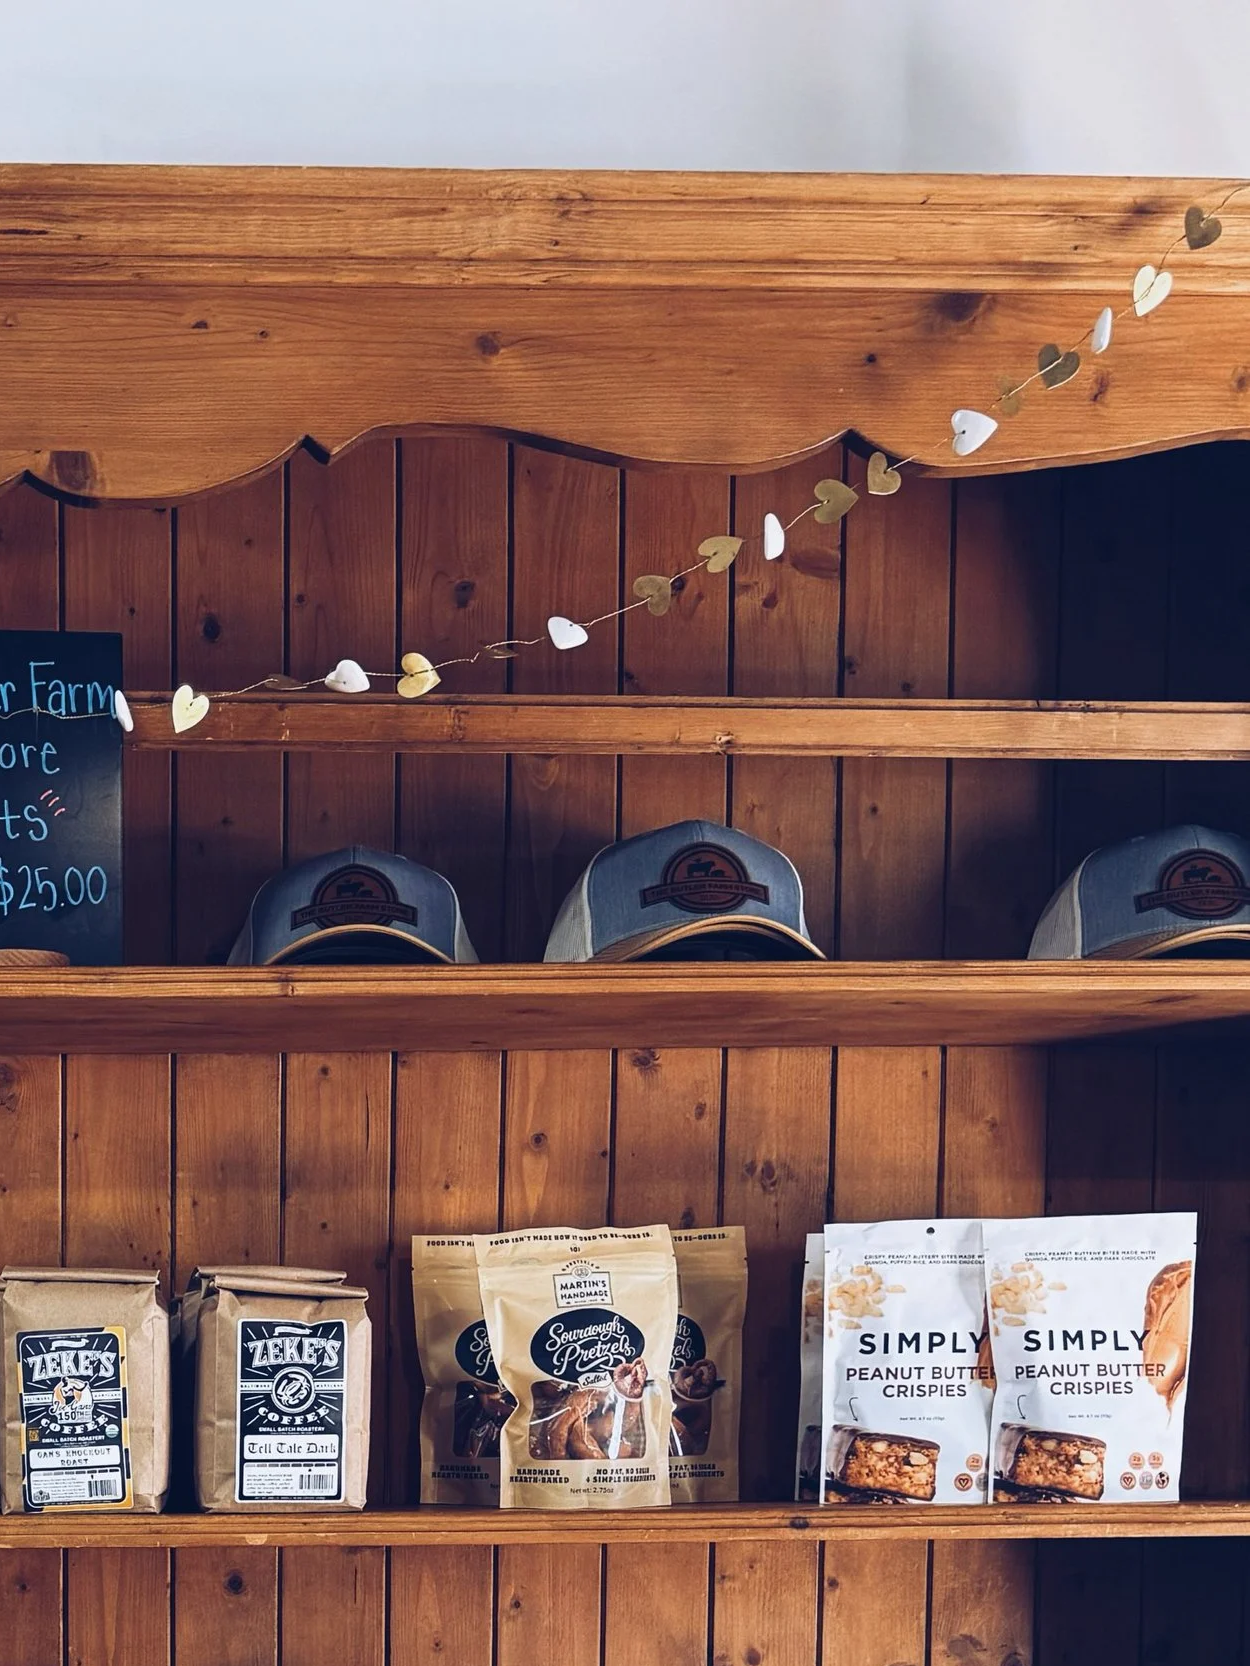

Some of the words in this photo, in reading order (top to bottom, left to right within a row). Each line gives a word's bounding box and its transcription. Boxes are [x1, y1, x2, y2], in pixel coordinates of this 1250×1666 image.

[29, 661, 118, 719] Farm
[490, 1238, 509, 1246] FOOD
[560, 1280, 606, 1290] MARTIN'S
[561, 1290, 608, 1300] HANDMADE
[546, 1315, 625, 1352] Sourdough
[1024, 1329, 1150, 1351] SIMPLY
[858, 1332, 989, 1355] SIMPLY
[247, 1337, 342, 1368] ZEKE'S
[553, 1339, 635, 1376] Pretzels
[27, 1350, 117, 1382] ZEKE'S
[846, 1367, 923, 1381] PEANUT
[1015, 1364, 1090, 1379] PEANUT
[1097, 1363, 1165, 1377] BUTTER
[882, 1384, 966, 1398] CRISPIES
[1050, 1381, 1133, 1395] CRISPIES
[258, 1406, 330, 1425] COFFEE
[41, 1414, 108, 1435] COFFEE
[248, 1442, 272, 1454] Tell
[276, 1442, 302, 1454] Tale
[306, 1442, 336, 1454] Dark
[61, 1458, 88, 1466] ROAST
